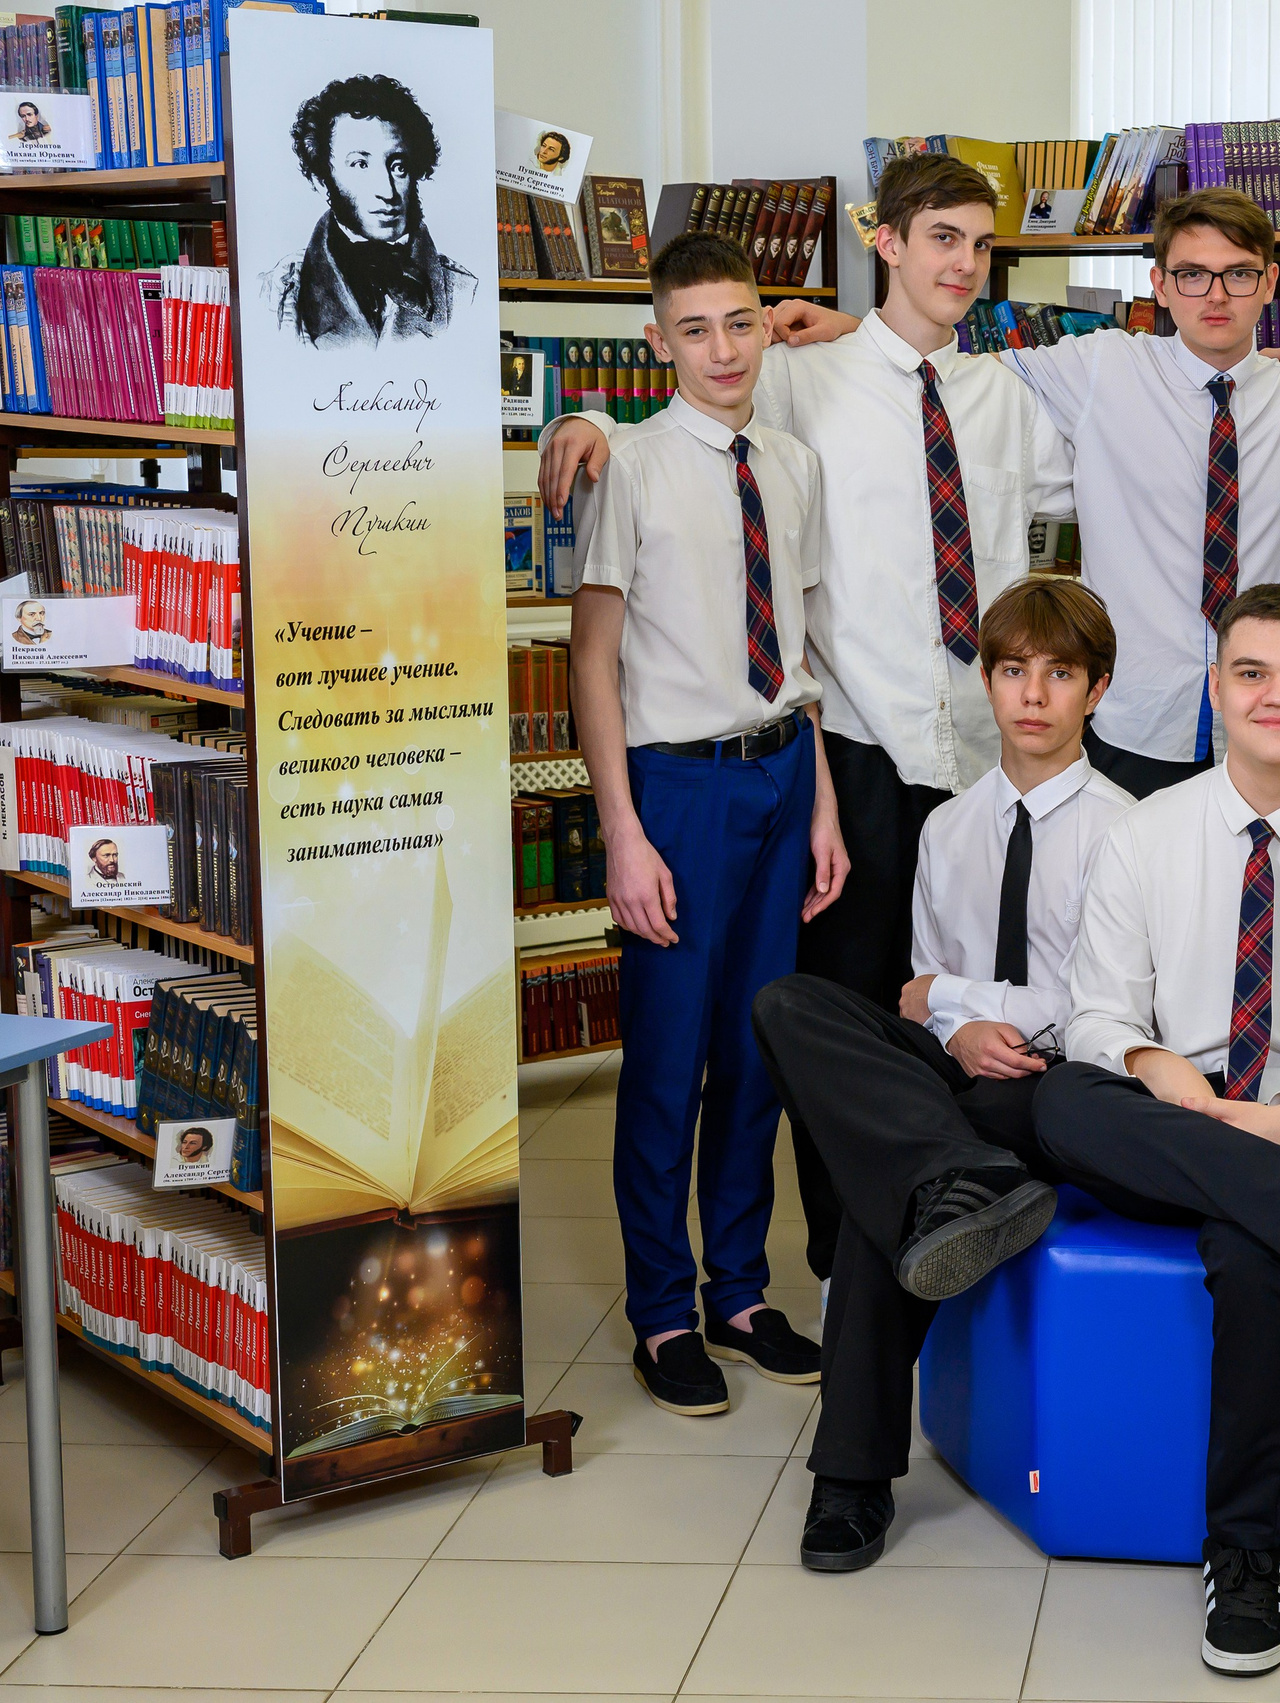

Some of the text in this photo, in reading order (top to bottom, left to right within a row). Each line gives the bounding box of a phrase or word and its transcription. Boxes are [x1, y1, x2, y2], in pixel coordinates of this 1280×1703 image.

[18, 142, 62, 150] Лермонтов
[39, 151, 75, 159] Юрьевич
[1174, 135, 1186, 148] Та
[518, 165, 549, 179] Пушкин
[865, 141, 880, 180] ДЭН БРАУ
[495, 169, 525, 182] ександр
[526, 176, 564, 193] Сергеевич
[313, 378, 441, 433] Александр
[322, 440, 435, 495] Сергеевич
[504, 506, 532, 518] БАКОВ
[331, 502, 431, 555] Пушкин
[136, 563, 144, 607] Некрасов
[274, 620, 356, 644] «Учение
[275, 660, 459, 690] вот лучшее учение.
[278, 700, 494, 733] Следовать за мыслями
[278, 754, 360, 777] великого
[365, 746, 445, 769] человека
[0, 772, 8, 828] НЕКРАСОВ
[280, 788, 444, 821] есть наука самая
[286, 832, 444, 864] занимательная»
[80, 890, 122, 898] Александр
[96, 880, 142, 889] Островский
[133, 985, 155, 997] Ост
[116, 1005, 125, 1055] Островский
[178, 1163, 210, 1171] Пушкин
